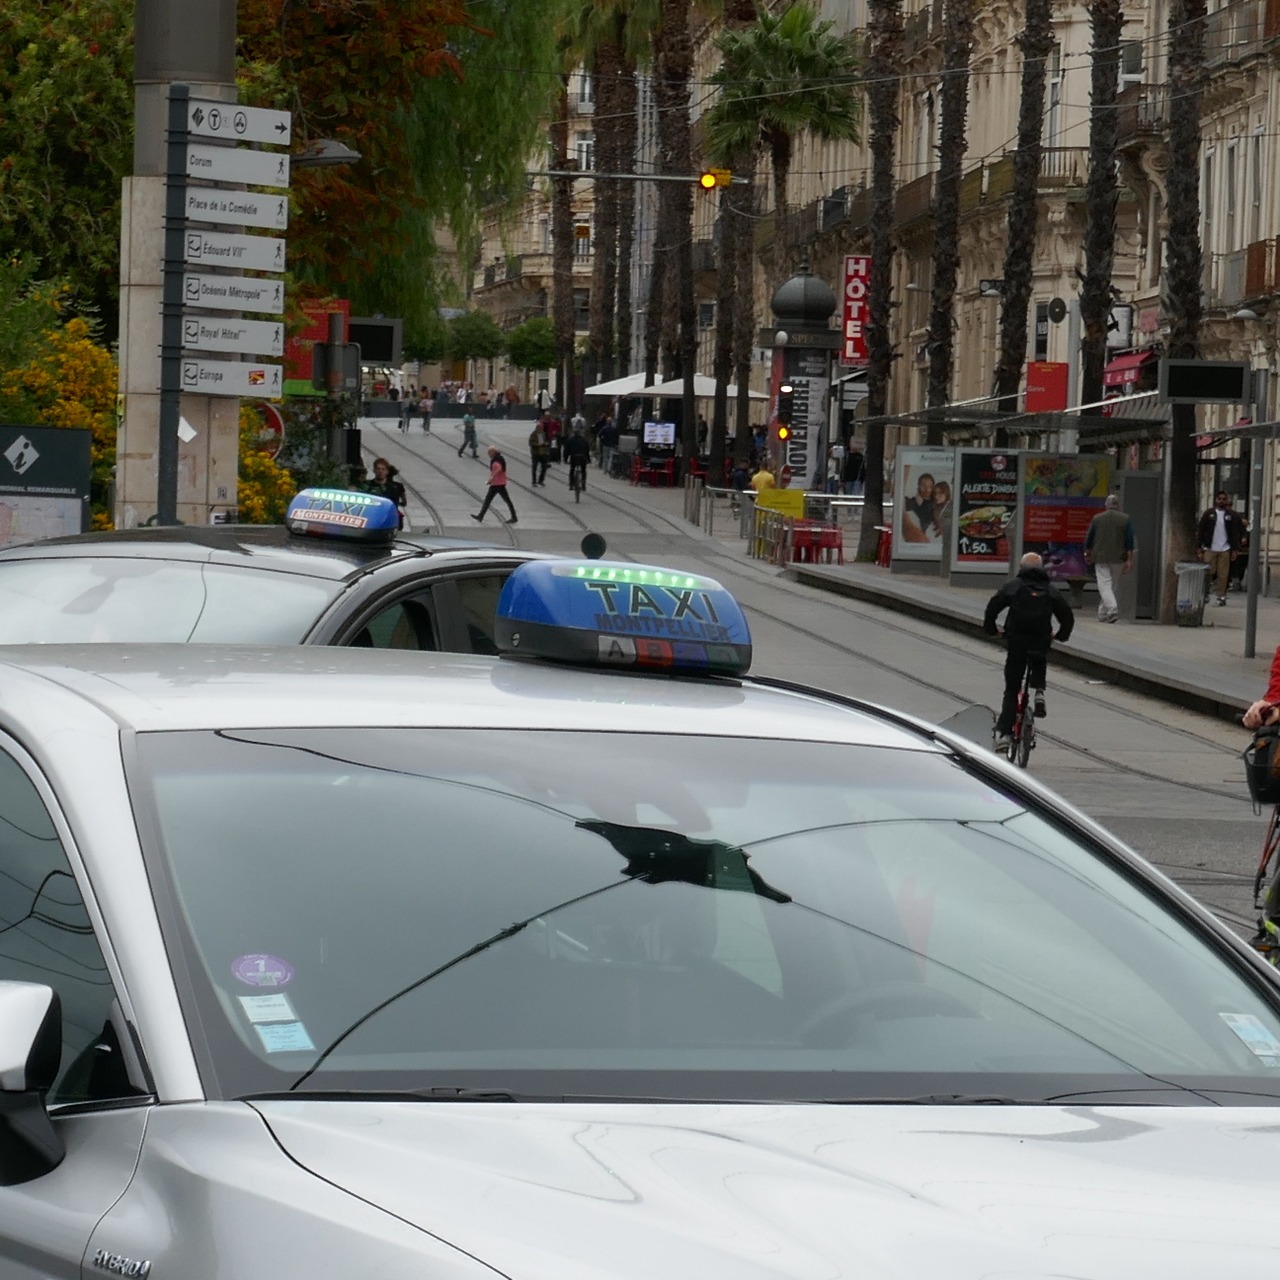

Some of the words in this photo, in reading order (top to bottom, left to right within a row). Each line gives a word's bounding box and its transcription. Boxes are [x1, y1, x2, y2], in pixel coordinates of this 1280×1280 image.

[189, 154, 213, 168] Corum
[188, 197, 208, 210] Place
[209, 200, 218, 211] de
[220, 202, 227, 212] la
[228, 202, 258, 216] Comédie
[845, 258, 867, 358] HÔTEL
[199, 326, 219, 342] Royal
[221, 328, 240, 340] Hôtel
[199, 368, 224, 382] Europa
[788, 380, 810, 478] NOVEMBRE
[27, 486, 77, 495] REMARQUABLE
[308, 499, 367, 517] TAXI
[294, 509, 364, 528] MONTPELLIER
[584, 581, 720, 626] TAXI
[594, 613, 729, 643] MONTPELLIER
